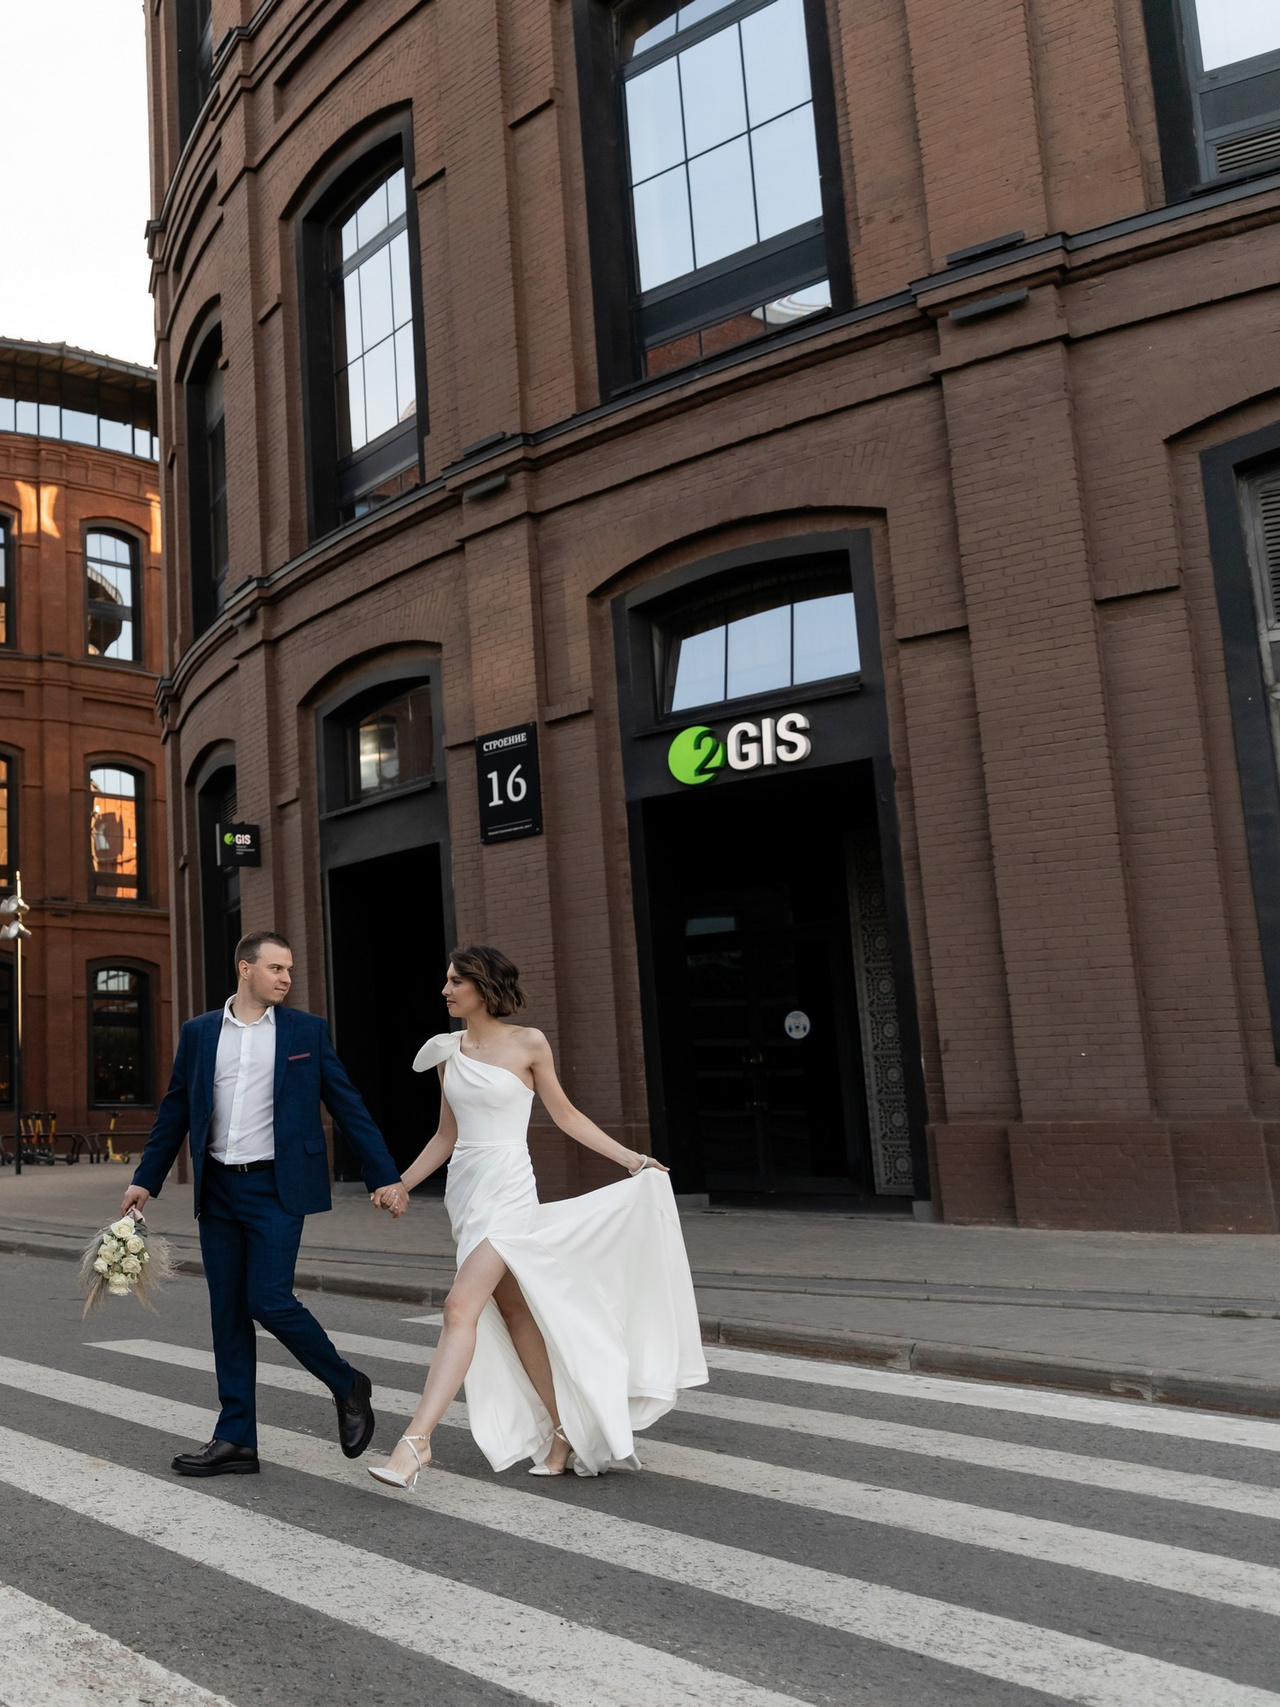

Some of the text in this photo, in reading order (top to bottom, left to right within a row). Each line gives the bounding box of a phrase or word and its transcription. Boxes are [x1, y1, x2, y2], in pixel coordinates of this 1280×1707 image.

[483, 732, 527, 752] СТРОЕНИЕ
[669, 712, 811, 785] 2GIS
[487, 763, 527, 807] 16
[223, 832, 251, 846] 2GIS
